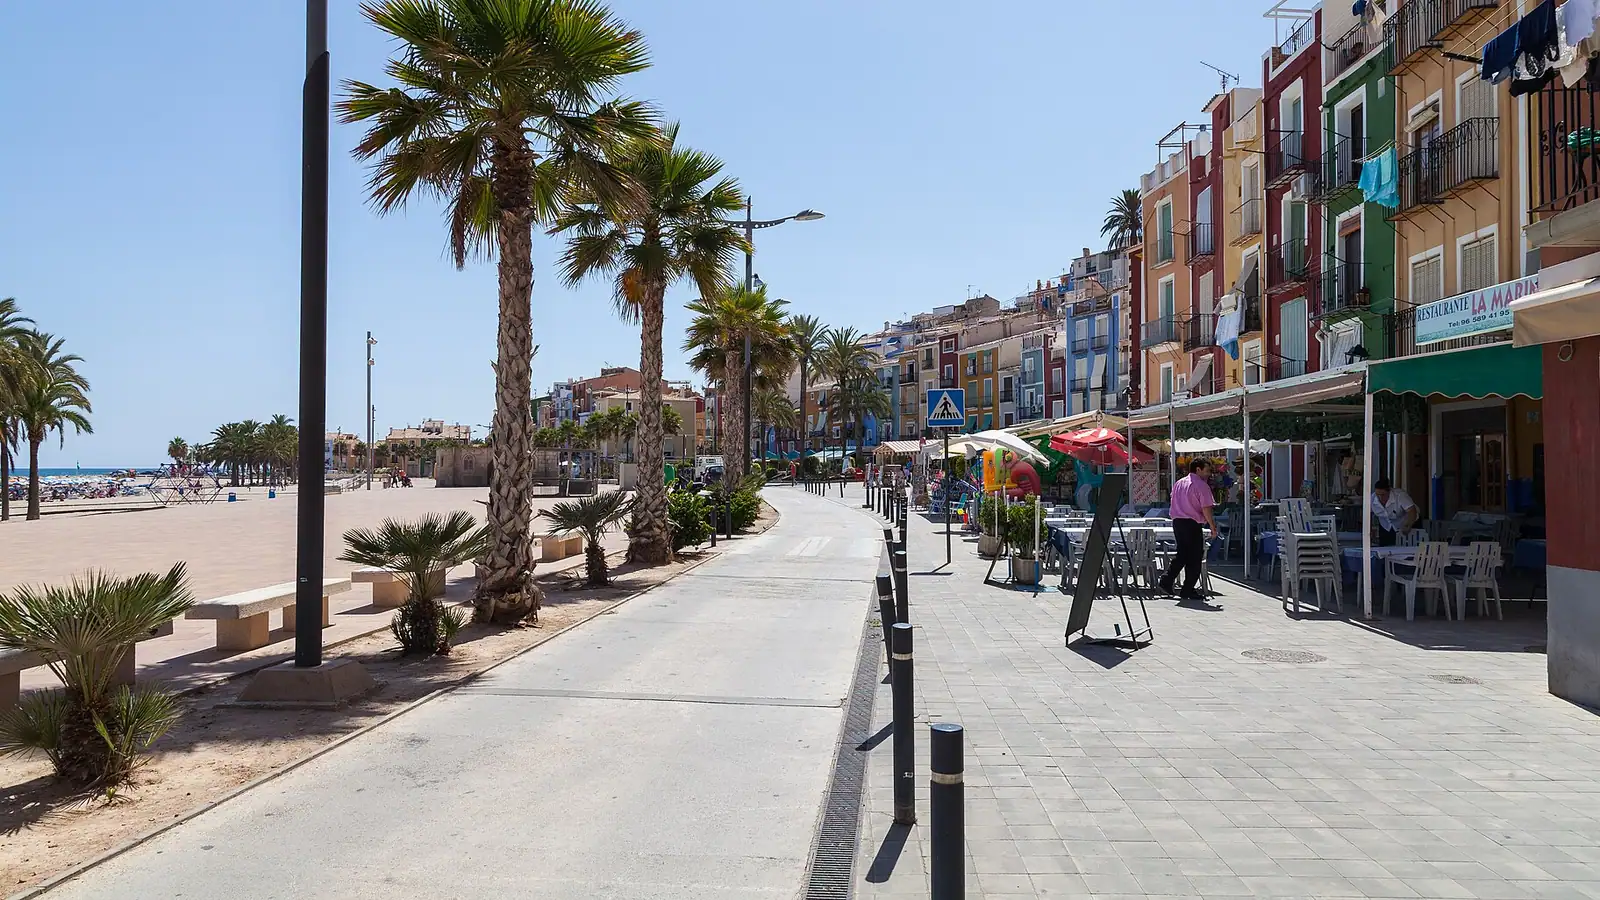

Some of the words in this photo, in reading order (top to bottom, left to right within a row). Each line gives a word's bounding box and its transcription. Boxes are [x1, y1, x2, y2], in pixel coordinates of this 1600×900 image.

[1417, 296, 1469, 322] RESTAURANTE
[1472, 291, 1487, 315] LA
[1472, 314, 1487, 323] 589
[1499, 309, 1510, 317] 95
